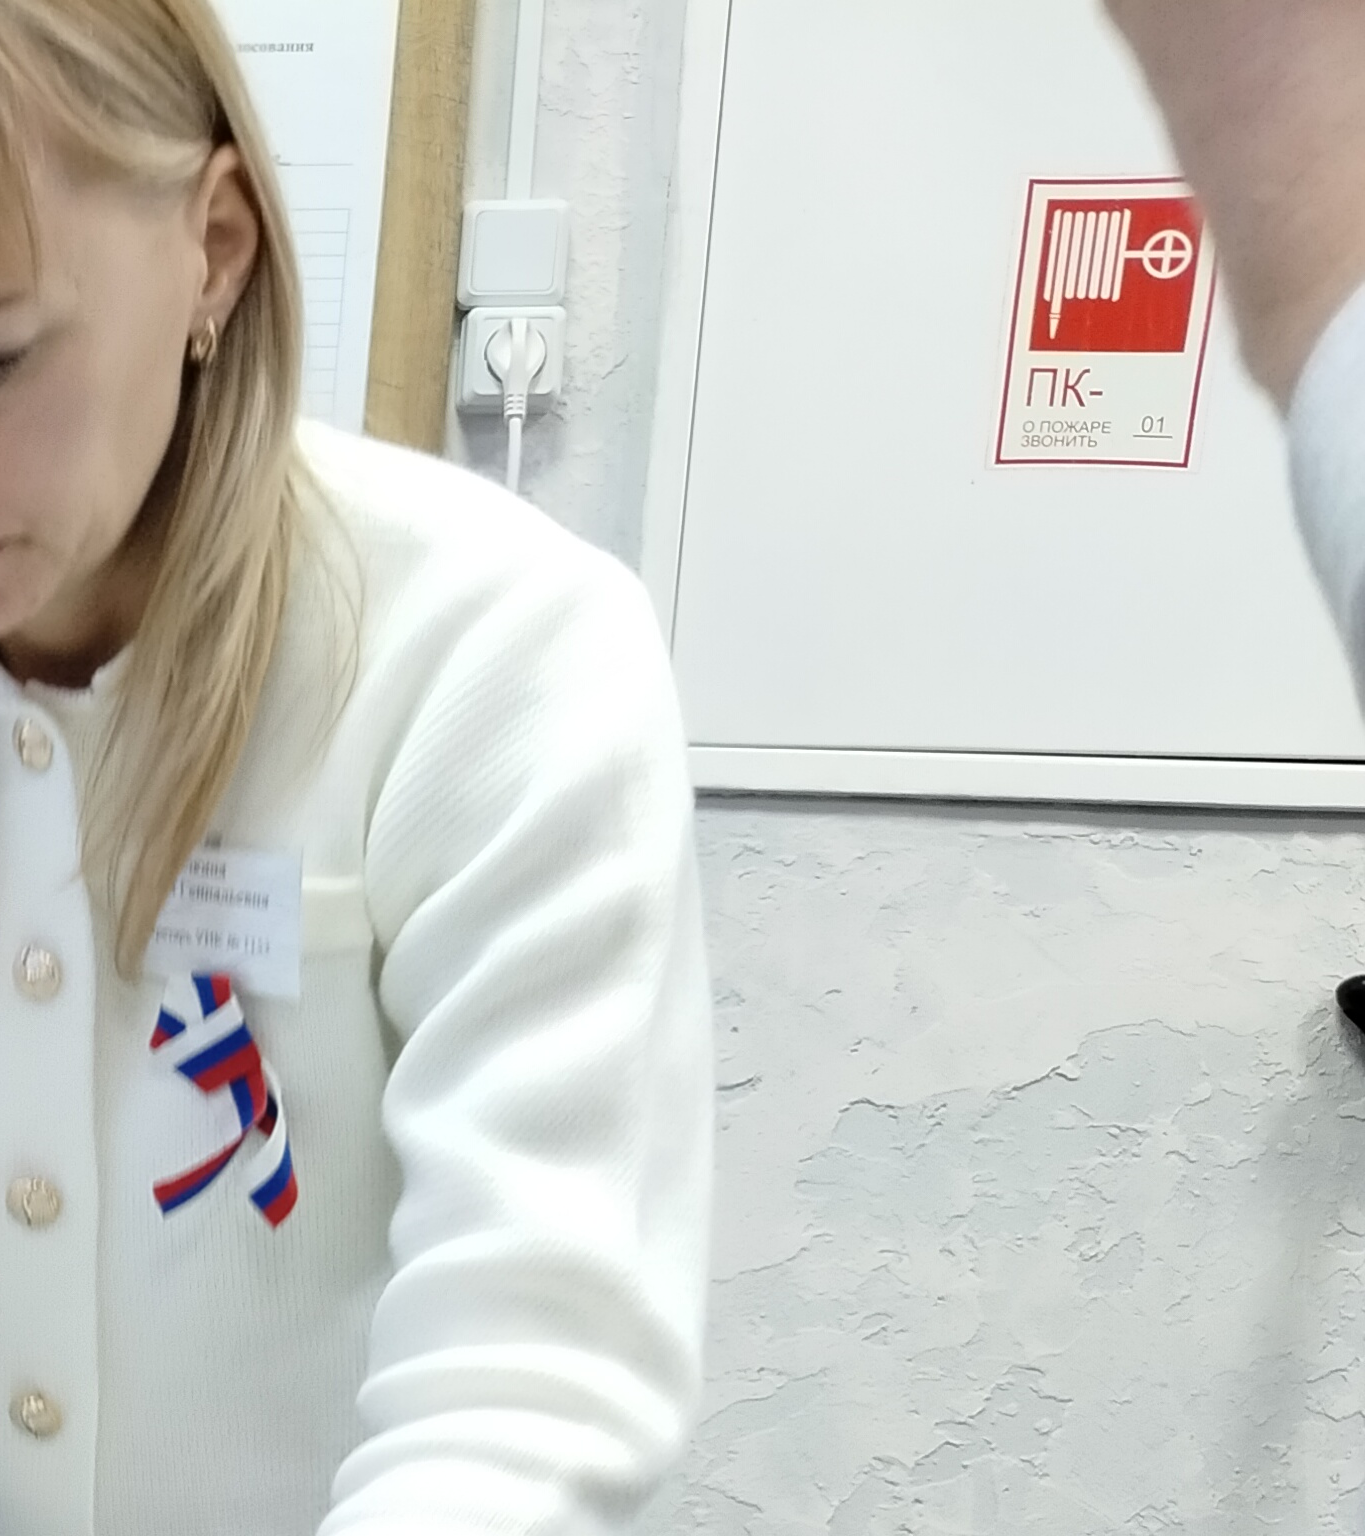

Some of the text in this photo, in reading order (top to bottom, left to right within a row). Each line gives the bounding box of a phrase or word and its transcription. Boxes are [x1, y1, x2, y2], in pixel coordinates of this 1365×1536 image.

[1026, 367, 1104, 408] ПК-
[1022, 420, 1112, 434] О ПОЖАРЕ
[1141, 416, 1166, 434] 01
[1020, 434, 1098, 448] ЗВОНИТЬ
